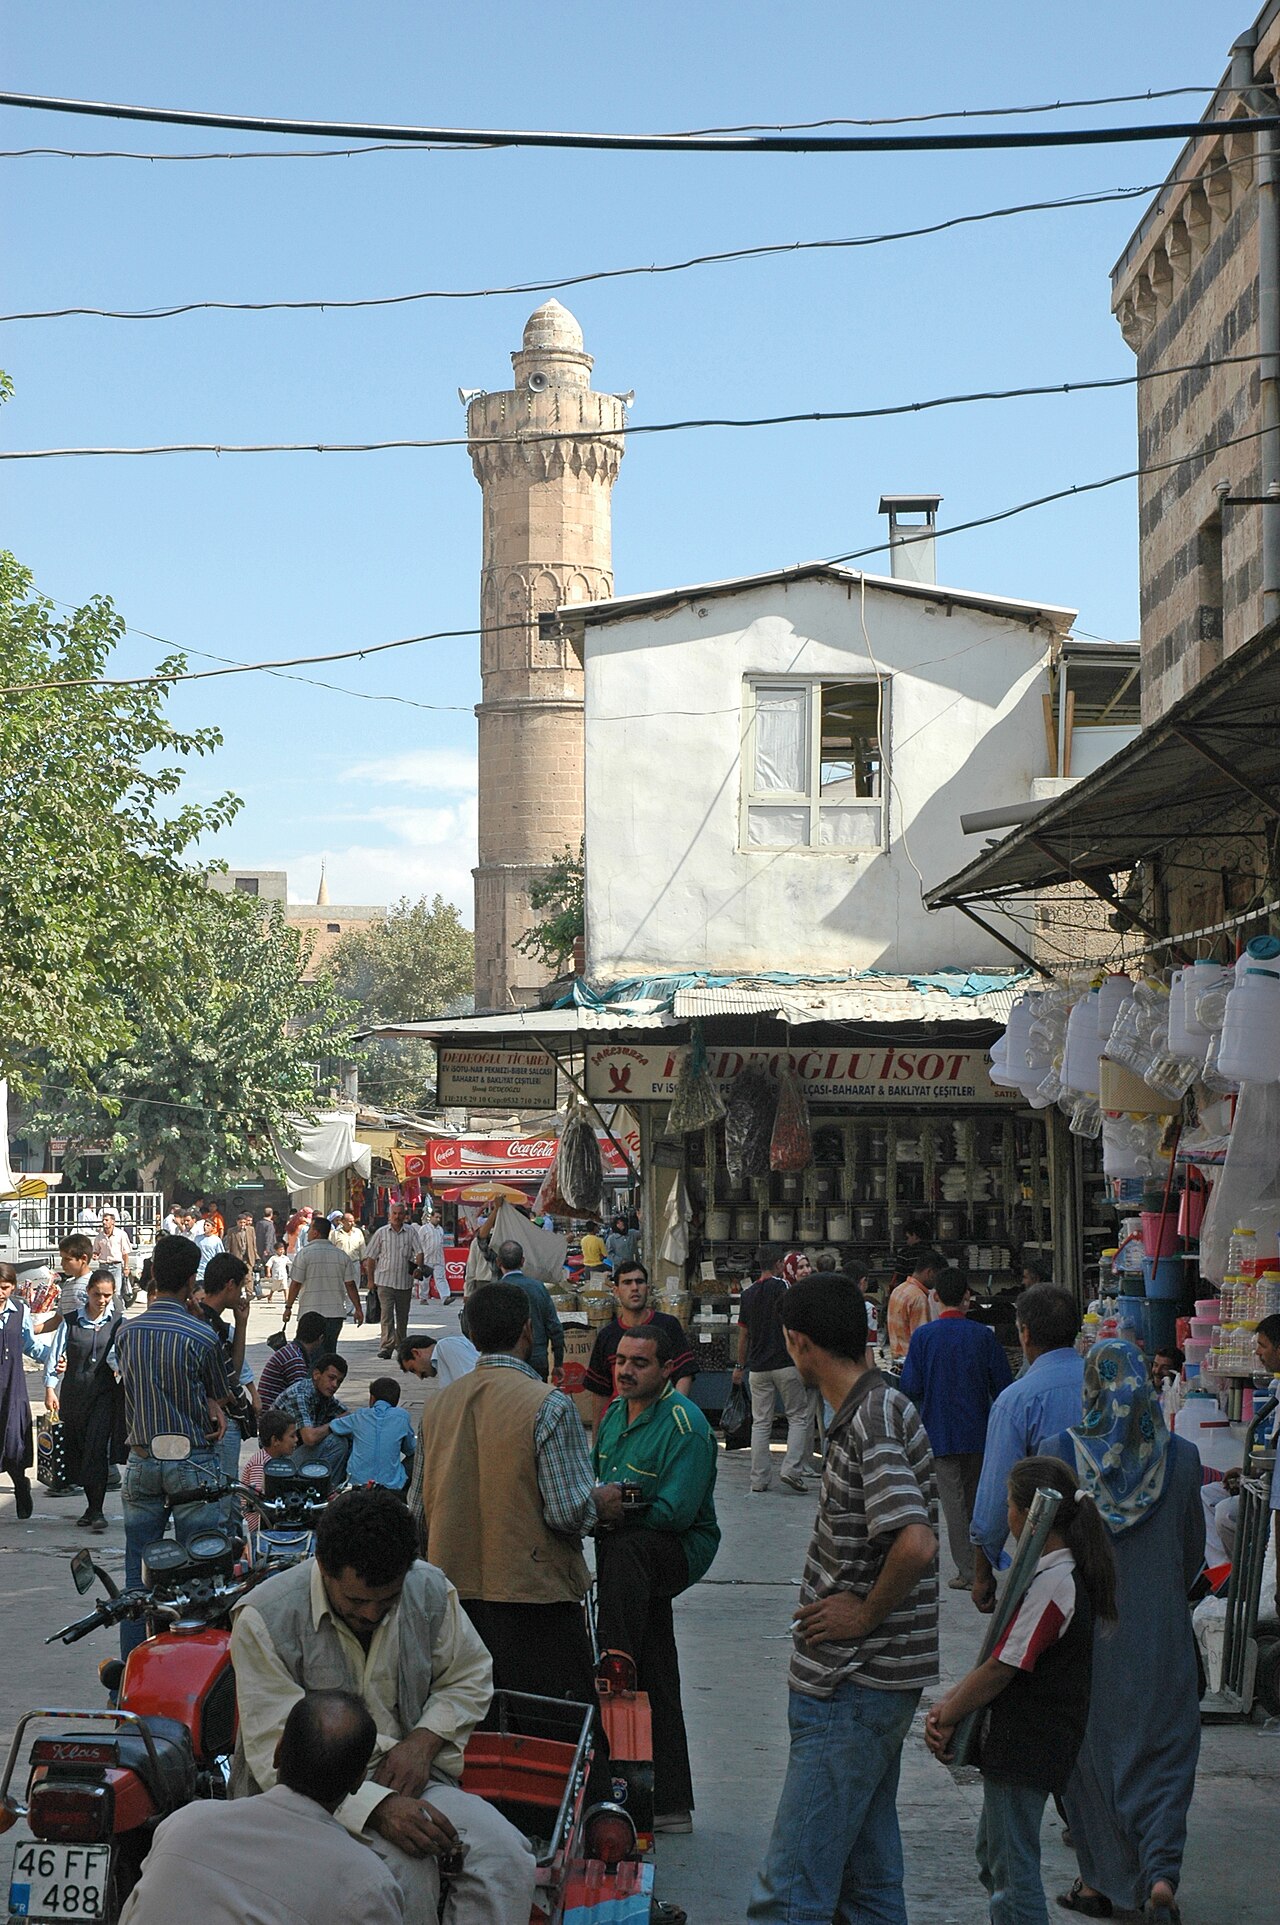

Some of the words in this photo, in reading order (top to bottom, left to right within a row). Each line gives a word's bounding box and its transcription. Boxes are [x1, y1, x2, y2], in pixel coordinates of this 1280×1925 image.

[878, 1047, 971, 1081] İSOT
[652, 1083, 663, 1093] EV
[878, 1086, 885, 1096] &
[18, 1848, 55, 1877] 46
[65, 1850, 107, 1880] FF
[42, 1884, 99, 1914] 488
